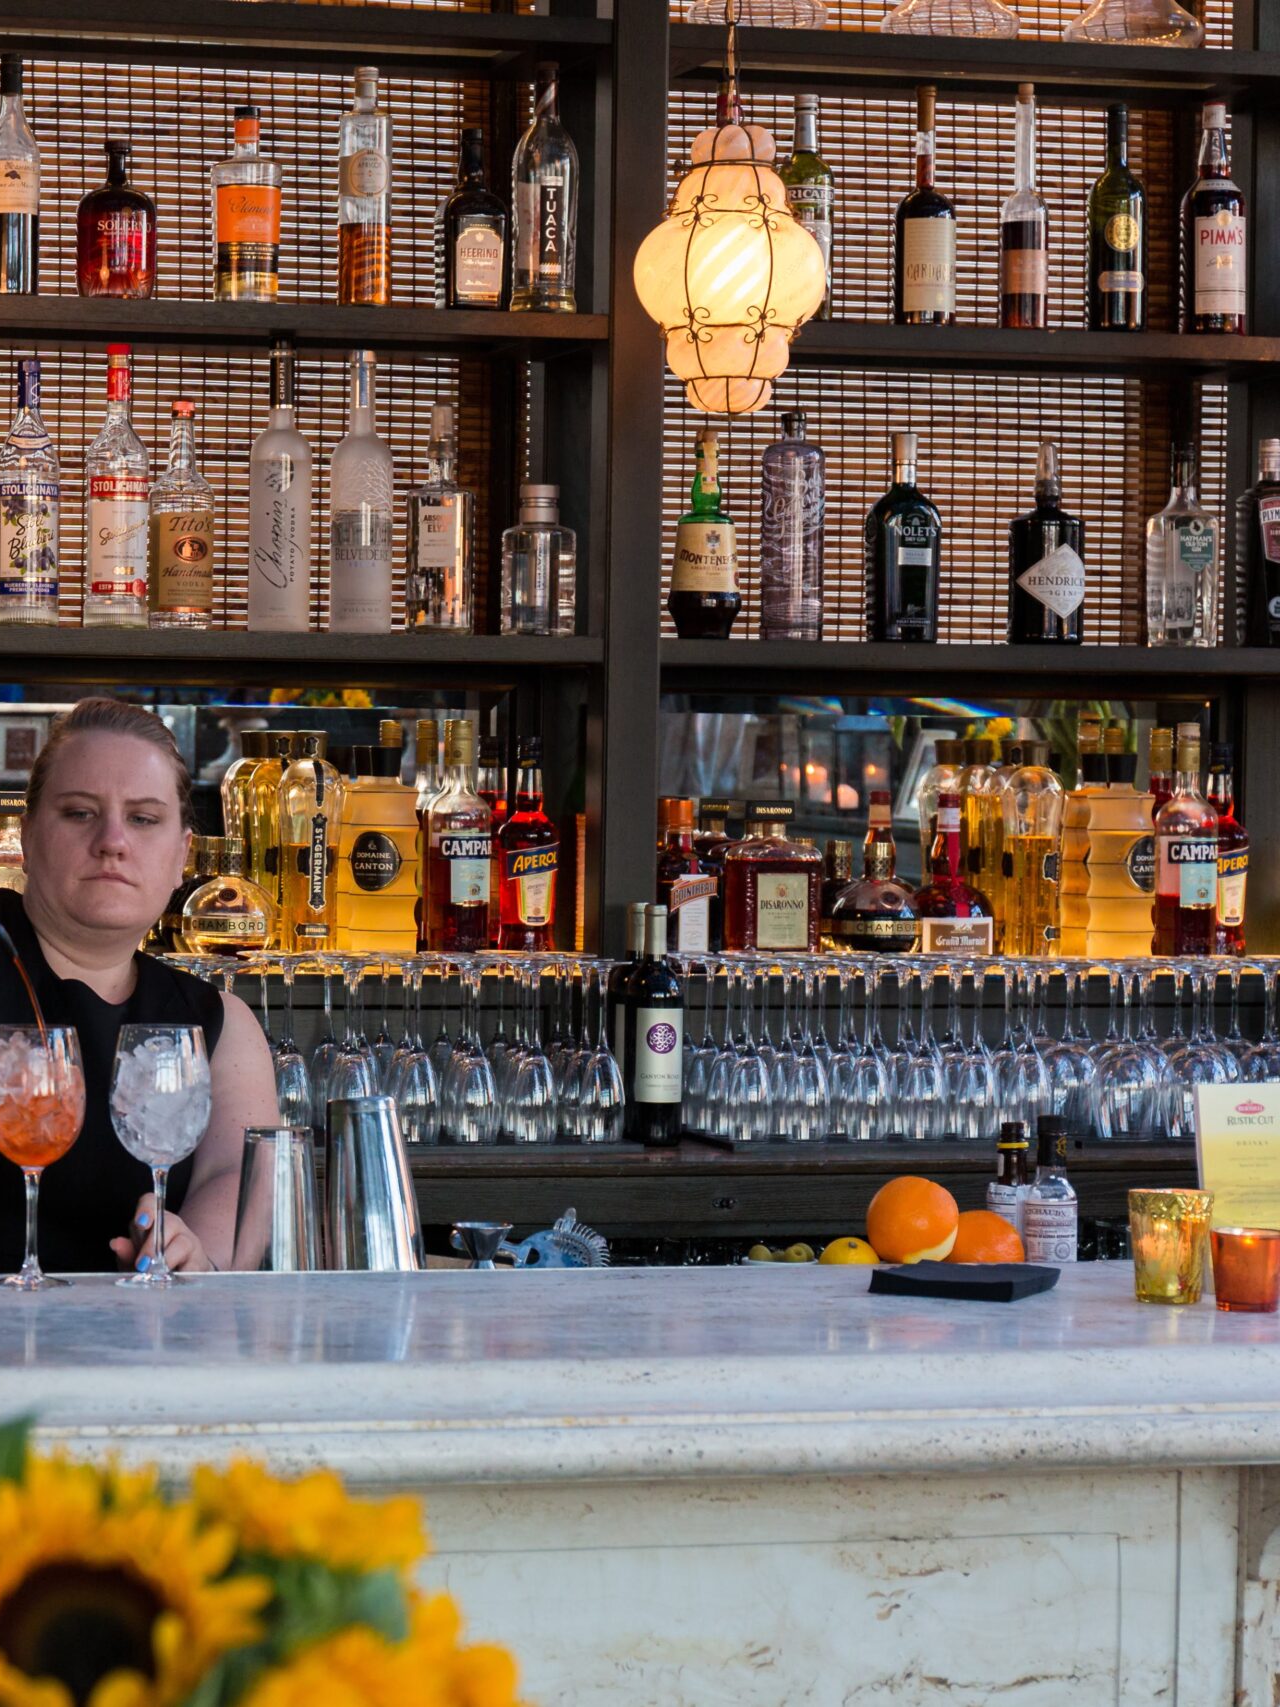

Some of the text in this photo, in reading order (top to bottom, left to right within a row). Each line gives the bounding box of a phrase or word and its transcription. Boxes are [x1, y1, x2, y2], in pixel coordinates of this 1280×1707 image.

[789, 189, 834, 199] RICARD
[545, 187, 558, 252] TUACA
[97, 220, 152, 233] SOLERNO
[1200, 226, 1243, 246] PIMM'S
[460, 248, 498, 258] HEERING
[1, 484, 57, 496] STOLICHNAYA
[169, 516, 212, 532] Tito's
[334, 547, 389, 561] BELVEDERE
[755, 807, 793, 815] DISARONNO
[313, 827, 323, 894] ST-GERMAIN
[354, 862, 393, 871] CANTON
[512, 851, 558, 874] APEROL
[673, 881, 717, 906] COINTREAU
[760, 899, 804, 911] DISARONNO
[191, 919, 265, 934] CHAMBORD
[936, 935, 987, 946] Grand Marnier
[1227, 1115, 1274, 1126] RUSTIC CUT
